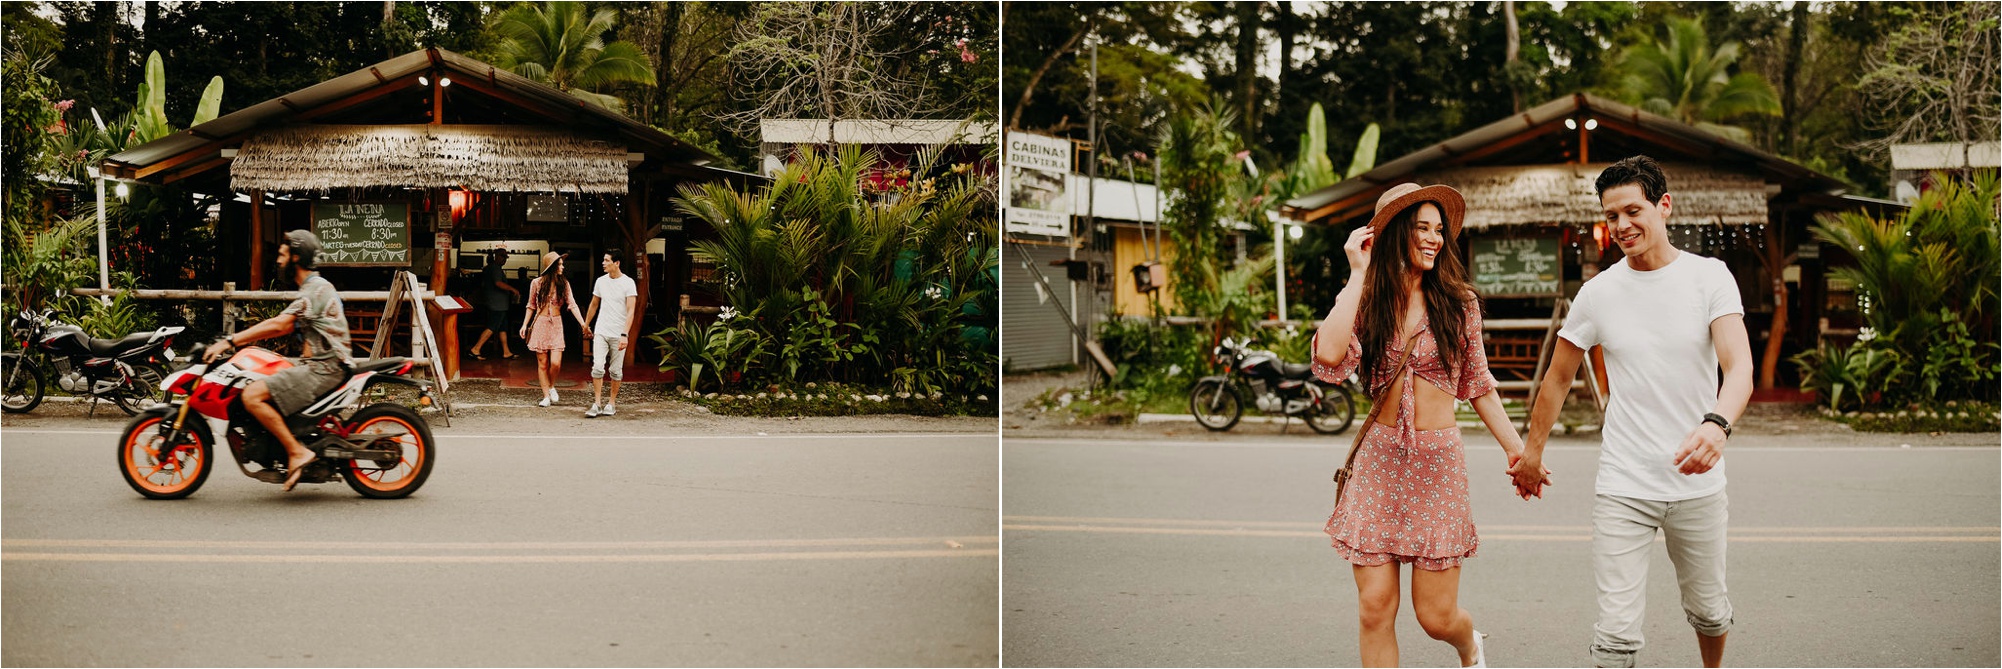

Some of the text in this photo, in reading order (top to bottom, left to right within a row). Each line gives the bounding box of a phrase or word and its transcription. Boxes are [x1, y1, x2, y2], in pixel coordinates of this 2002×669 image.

[1012, 140, 1066, 158] CABINAS
[1012, 153, 1066, 169] DELVIERA
[338, 203, 385, 214] LA NENA
[363, 217, 388, 227] CERRADO
[321, 228, 343, 239] 11:30
[371, 228, 391, 239] 8:30
[362, 240, 386, 249] CERRADO
